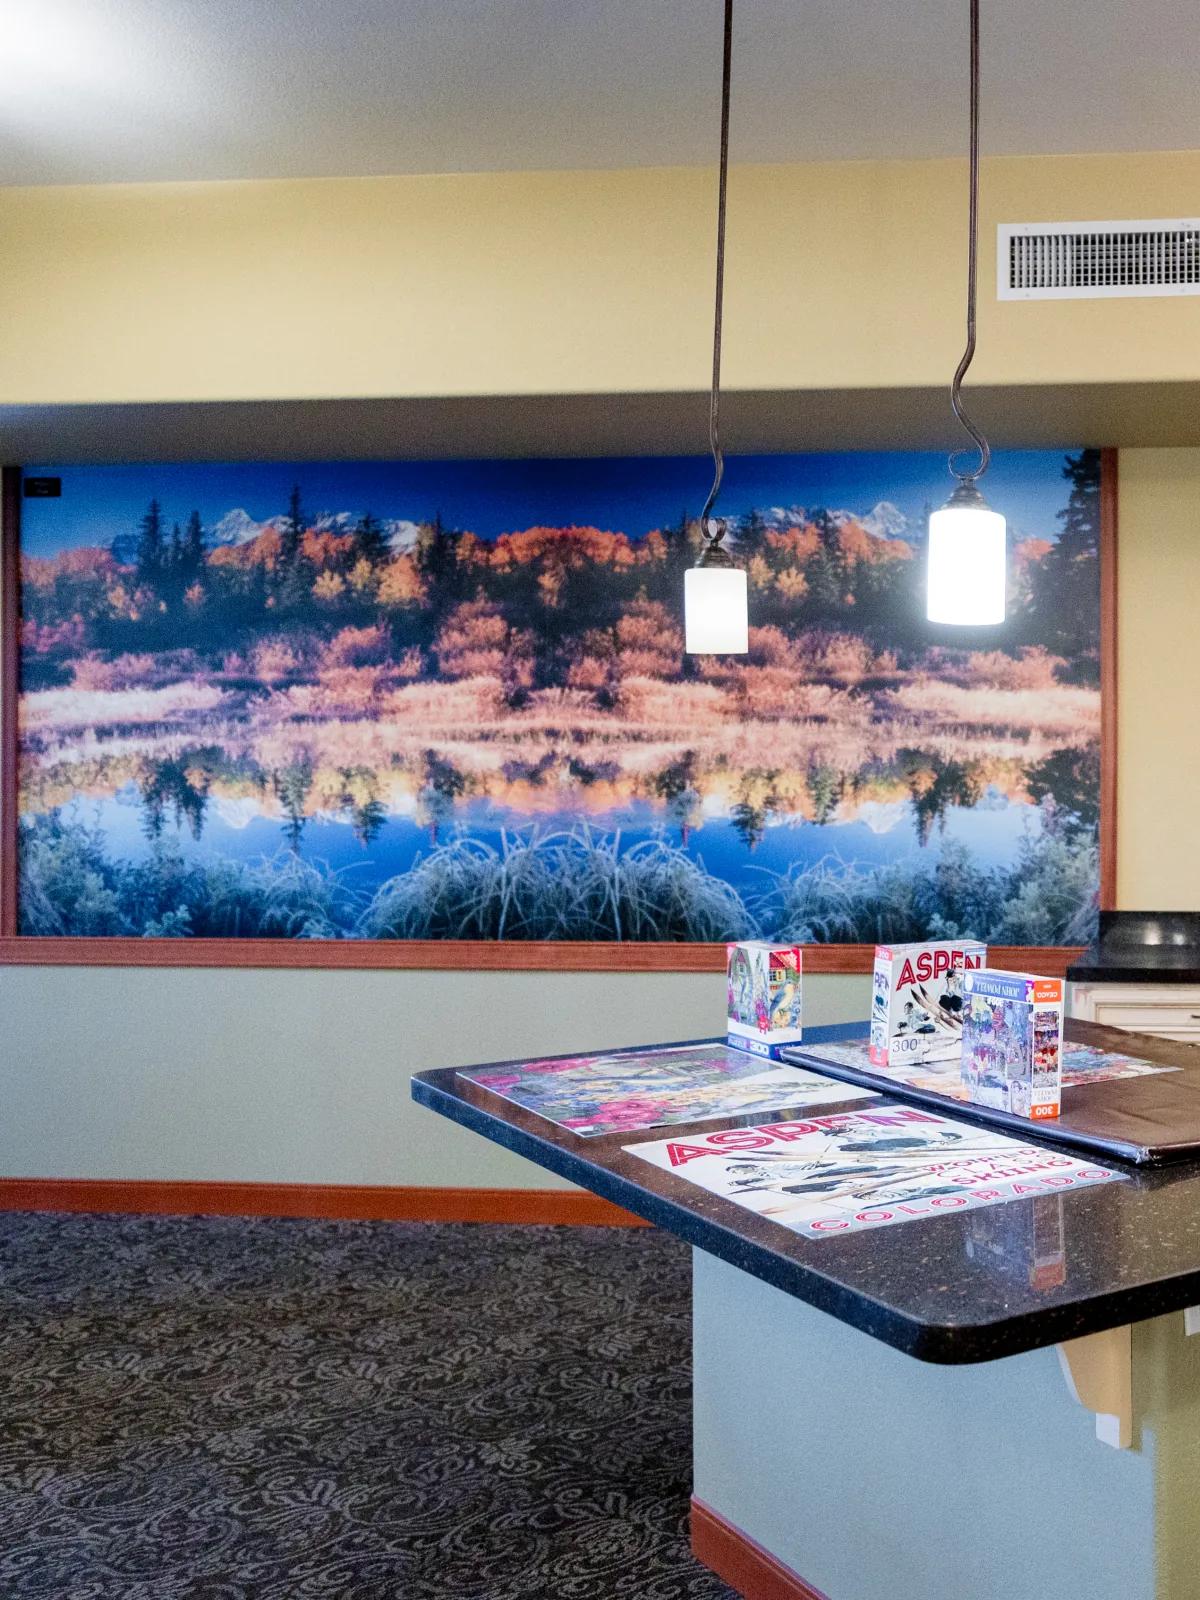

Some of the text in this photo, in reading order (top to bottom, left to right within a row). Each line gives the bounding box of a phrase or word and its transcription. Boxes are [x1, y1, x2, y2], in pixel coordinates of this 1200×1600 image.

[896, 950, 981, 992] ASPEN
[976, 981, 1020, 998] JOHN POWELL
[750, 1039, 770, 1056] 300
[893, 1038, 919, 1053] 300
[1035, 1105, 1054, 1116] 300
[665, 1110, 947, 1167] ASPEN
[923, 1149, 1036, 1173] WORLD
[937, 1154, 1066, 1178] CLASS
[951, 1160, 1073, 1185] SKIING
[809, 1169, 1111, 1230] COLORADO
